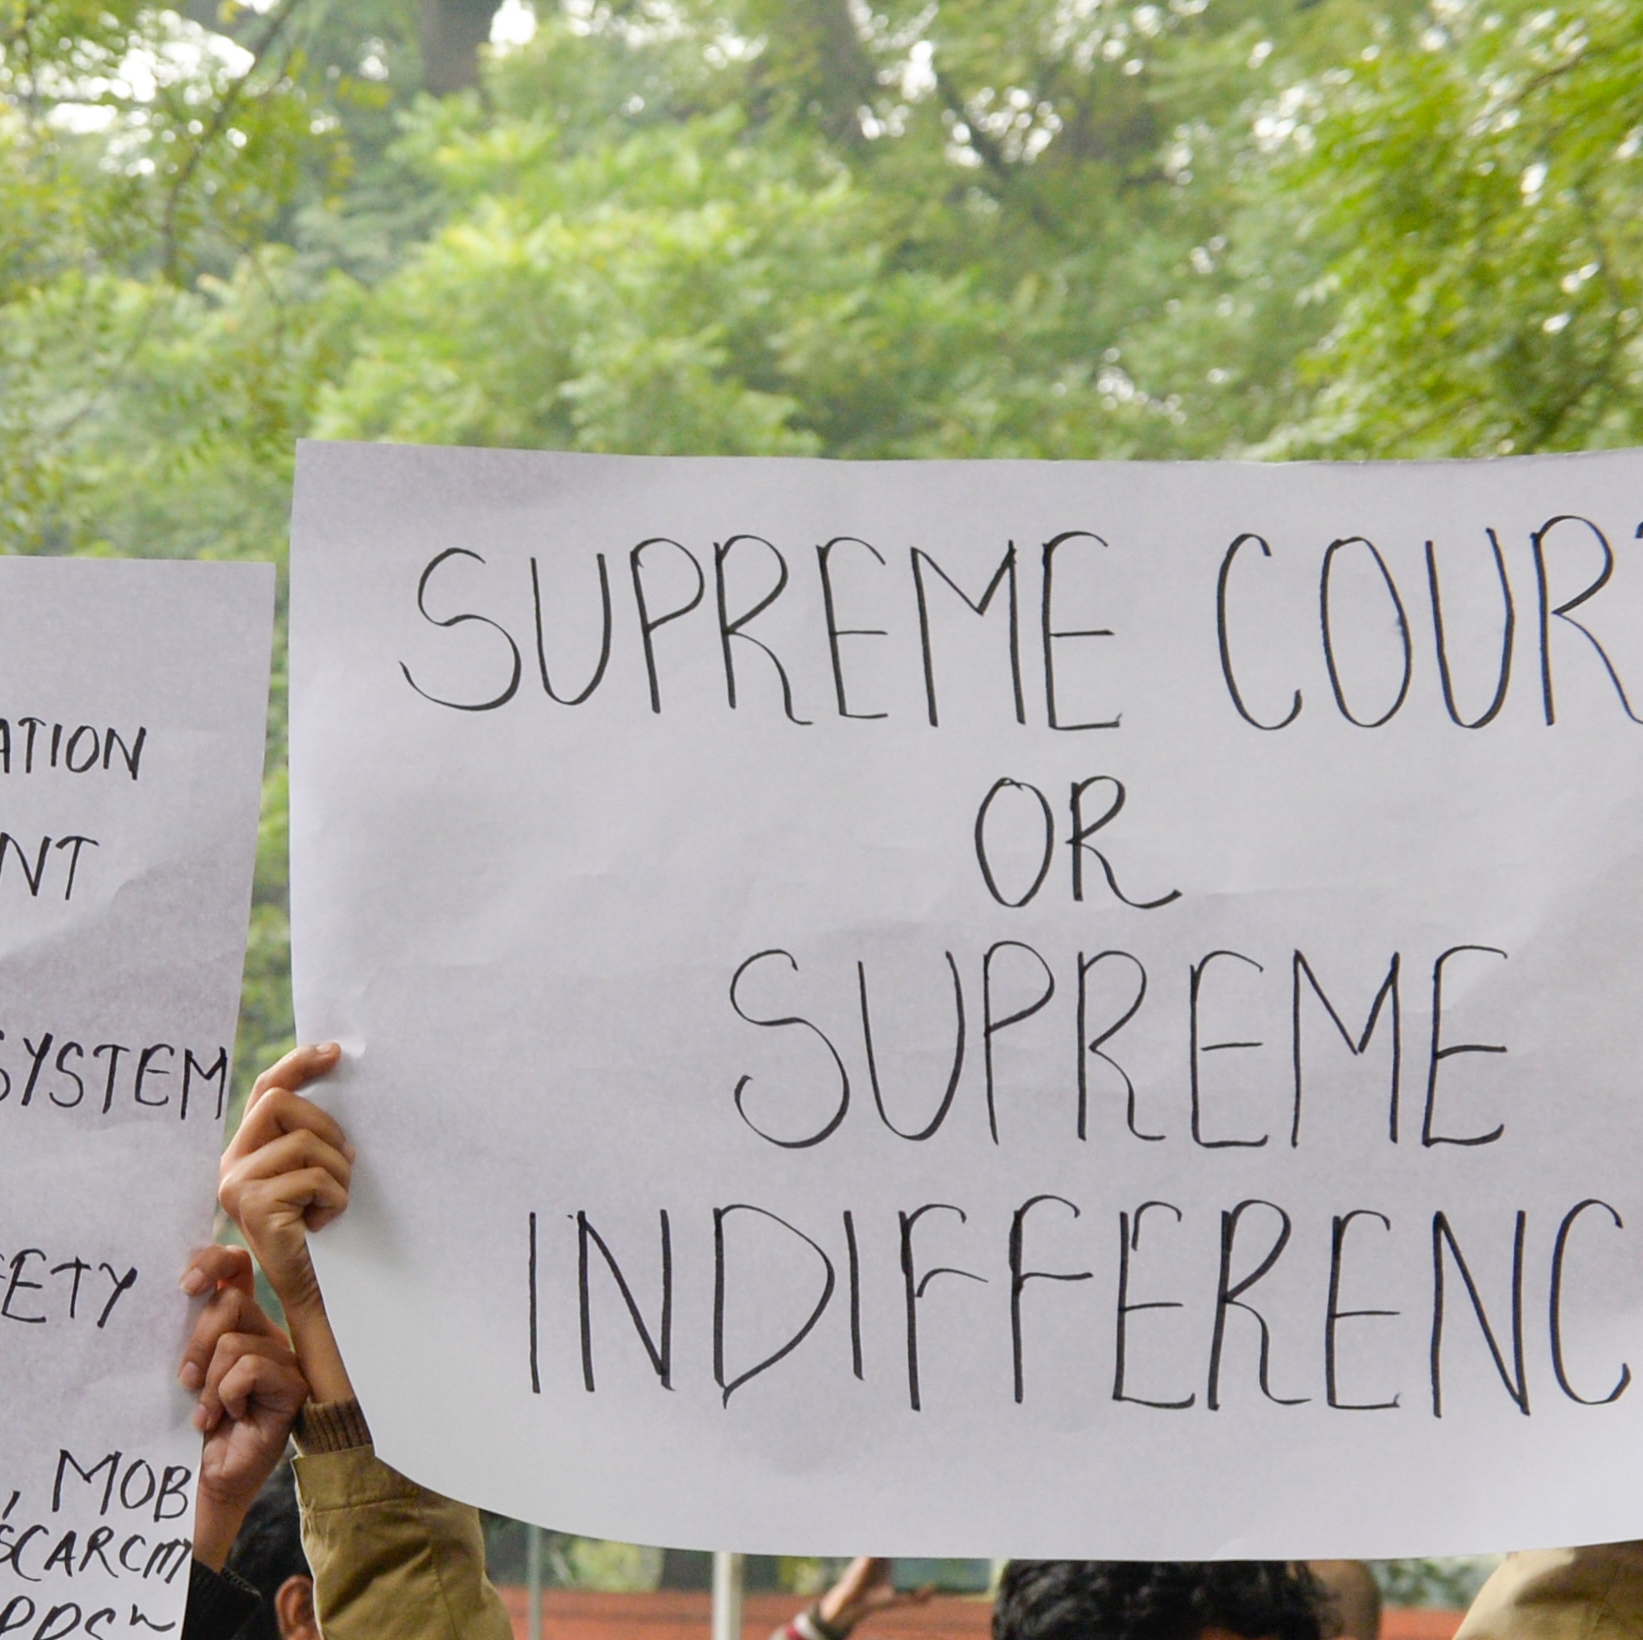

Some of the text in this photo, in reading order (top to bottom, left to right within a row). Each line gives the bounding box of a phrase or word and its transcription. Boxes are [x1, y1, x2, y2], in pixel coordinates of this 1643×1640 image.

[397, 513, 1643, 733] SUPREME COUR
[972, 774, 1184, 911] OR
[728, 939, 1510, 1151] SUPREME
[527, 1193, 1633, 1421] INDIFFERENC
[50, 1447, 193, 1524] MOB
